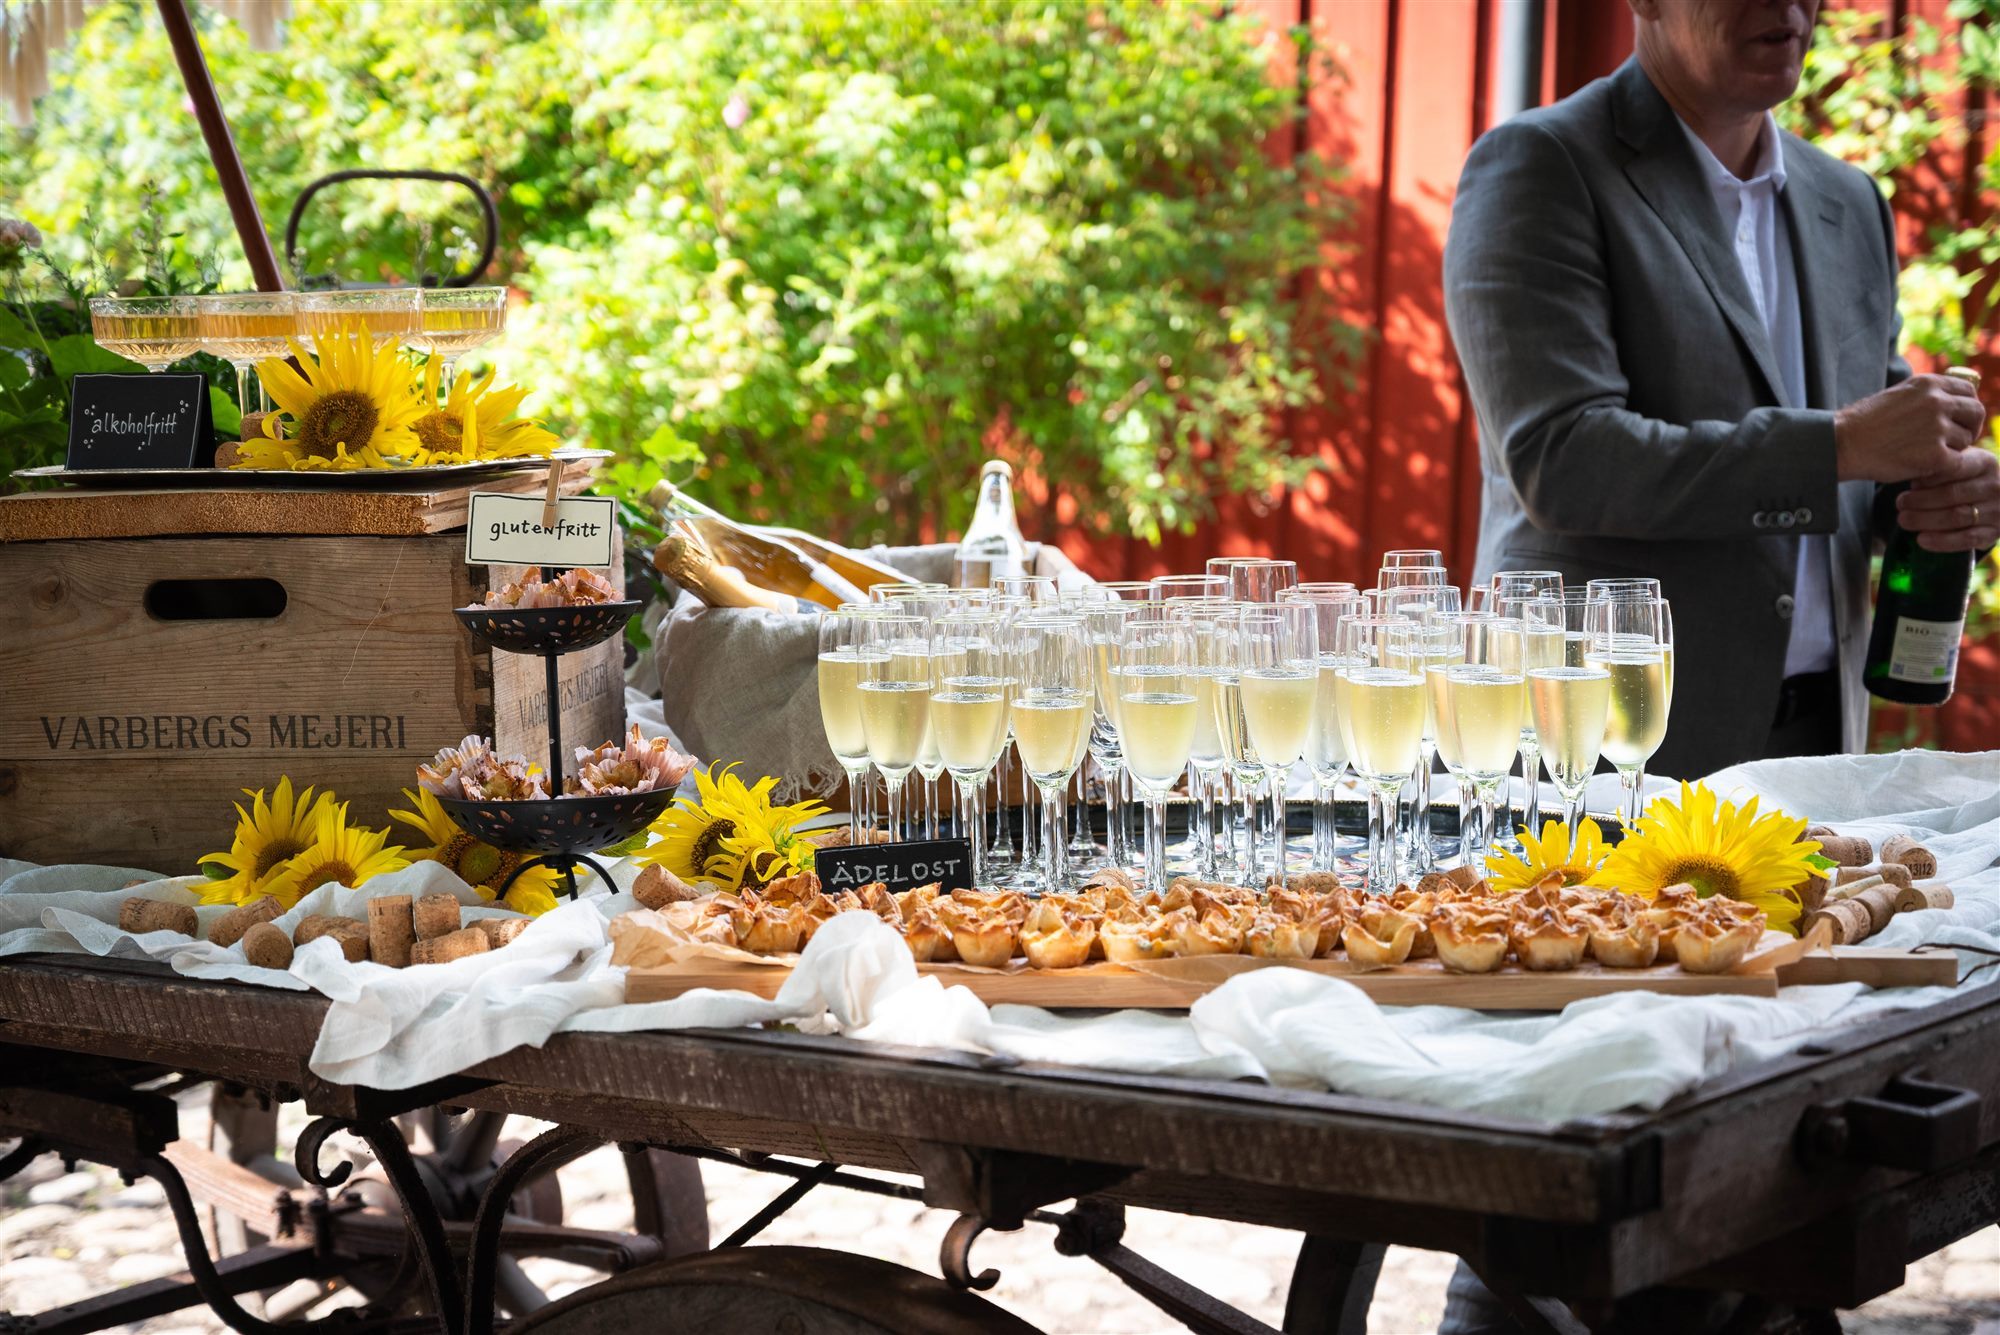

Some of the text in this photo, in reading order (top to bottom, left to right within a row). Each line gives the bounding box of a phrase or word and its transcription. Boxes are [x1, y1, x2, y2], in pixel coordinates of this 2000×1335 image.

[91, 411, 177, 446] alkoholfritt
[518, 678, 574, 732] VARBGS
[39, 715, 406, 750] VARBERGS MEJERI
[830, 858, 961, 885] ÄDELOST
